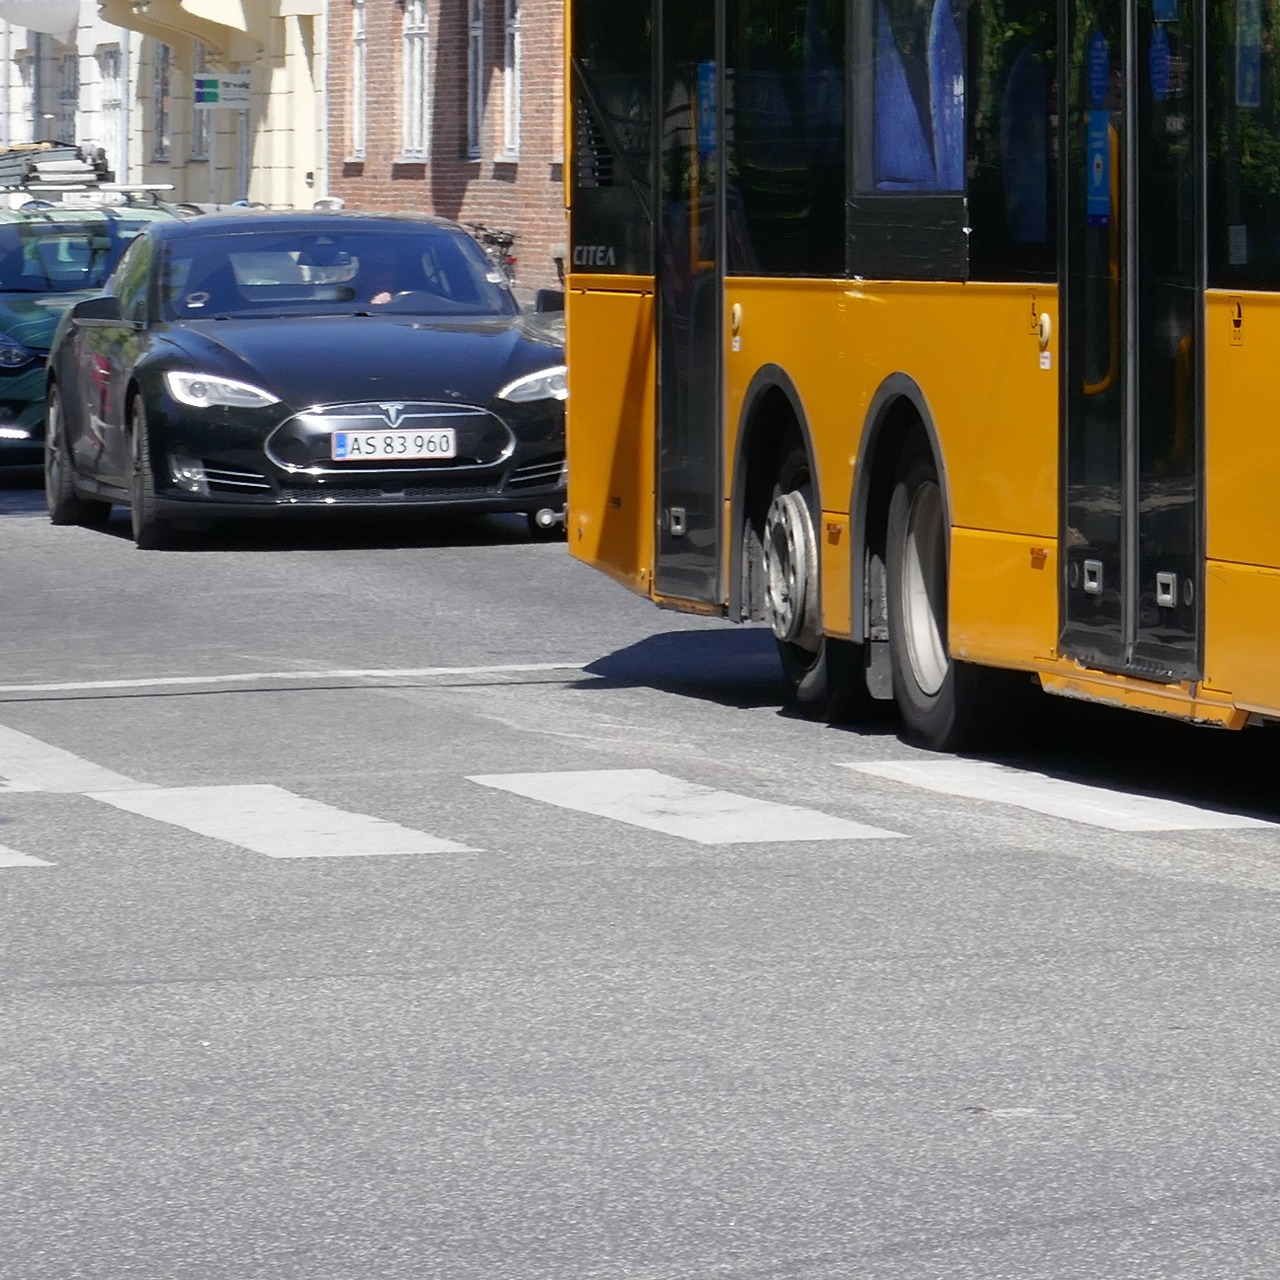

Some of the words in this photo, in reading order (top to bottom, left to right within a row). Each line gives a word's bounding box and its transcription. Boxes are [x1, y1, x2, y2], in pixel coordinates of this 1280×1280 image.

[573, 245, 616, 266] CITEA
[350, 436, 377, 455] AS
[383, 435, 407, 454] 83
[414, 434, 450, 453] 960
